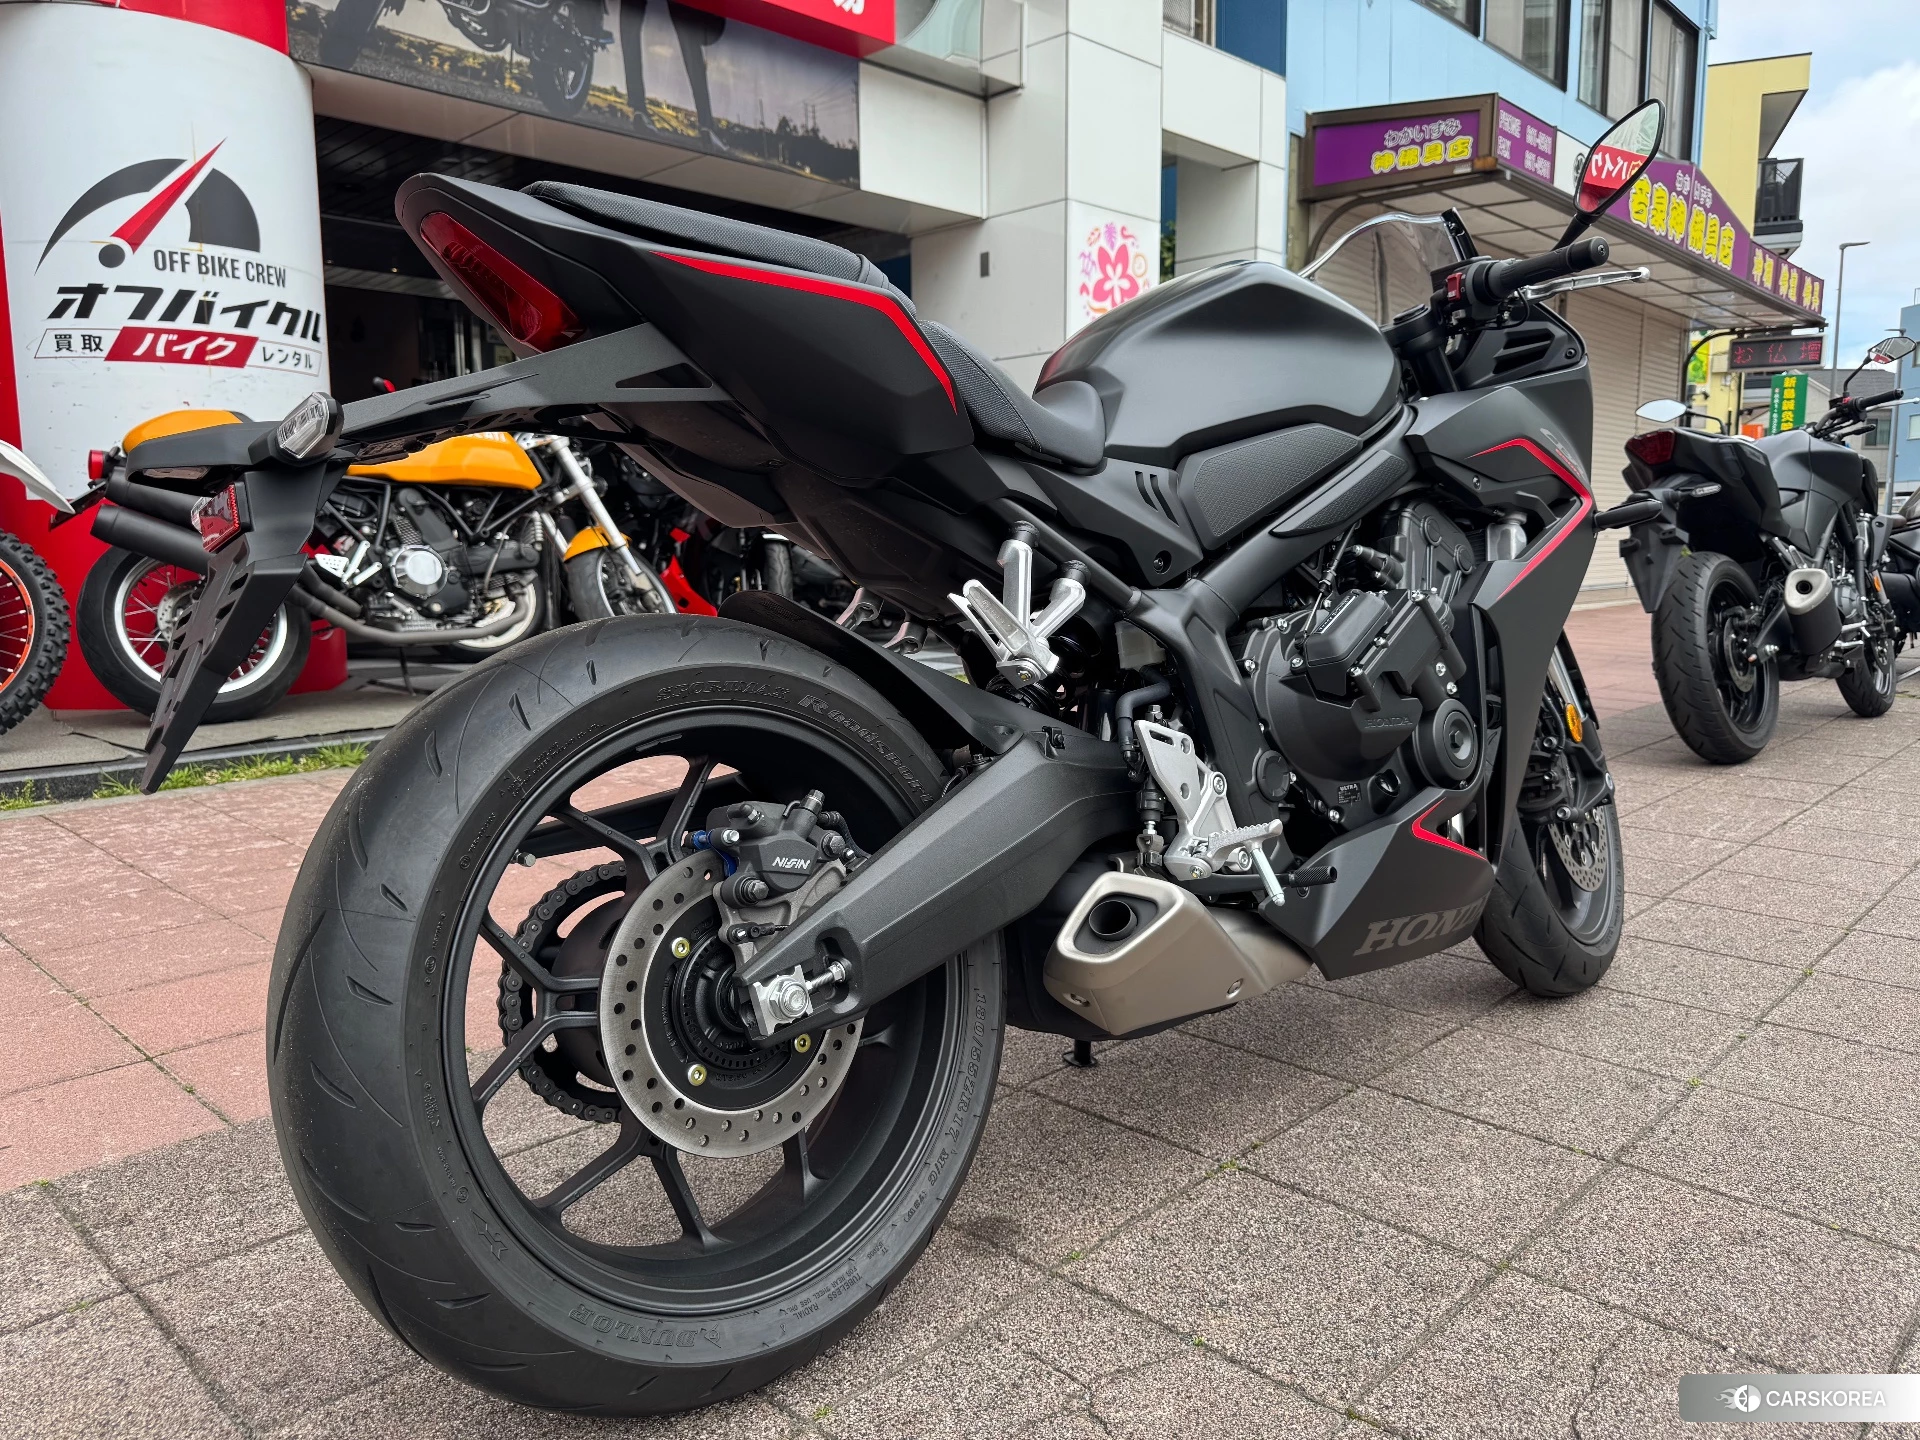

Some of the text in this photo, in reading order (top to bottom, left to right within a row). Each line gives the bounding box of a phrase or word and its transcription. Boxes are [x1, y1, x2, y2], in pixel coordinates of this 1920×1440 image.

[1384, 118, 1462, 148] わかいずみ
[153, 249, 286, 289] OFF BIKE CREW
[46, 283, 321, 343] オフバイクル
[54, 332, 313, 370] 買取 バイク レンタル
[1364, 716, 1413, 729] HONDA
[772, 856, 810, 870] NISSIN
[791, 1272, 863, 1320] TUBELESS RADIAL
[830, 1275, 846, 1289] REAR
[799, 1297, 811, 1307] USE
[568, 1302, 698, 1348] DUNLOP
